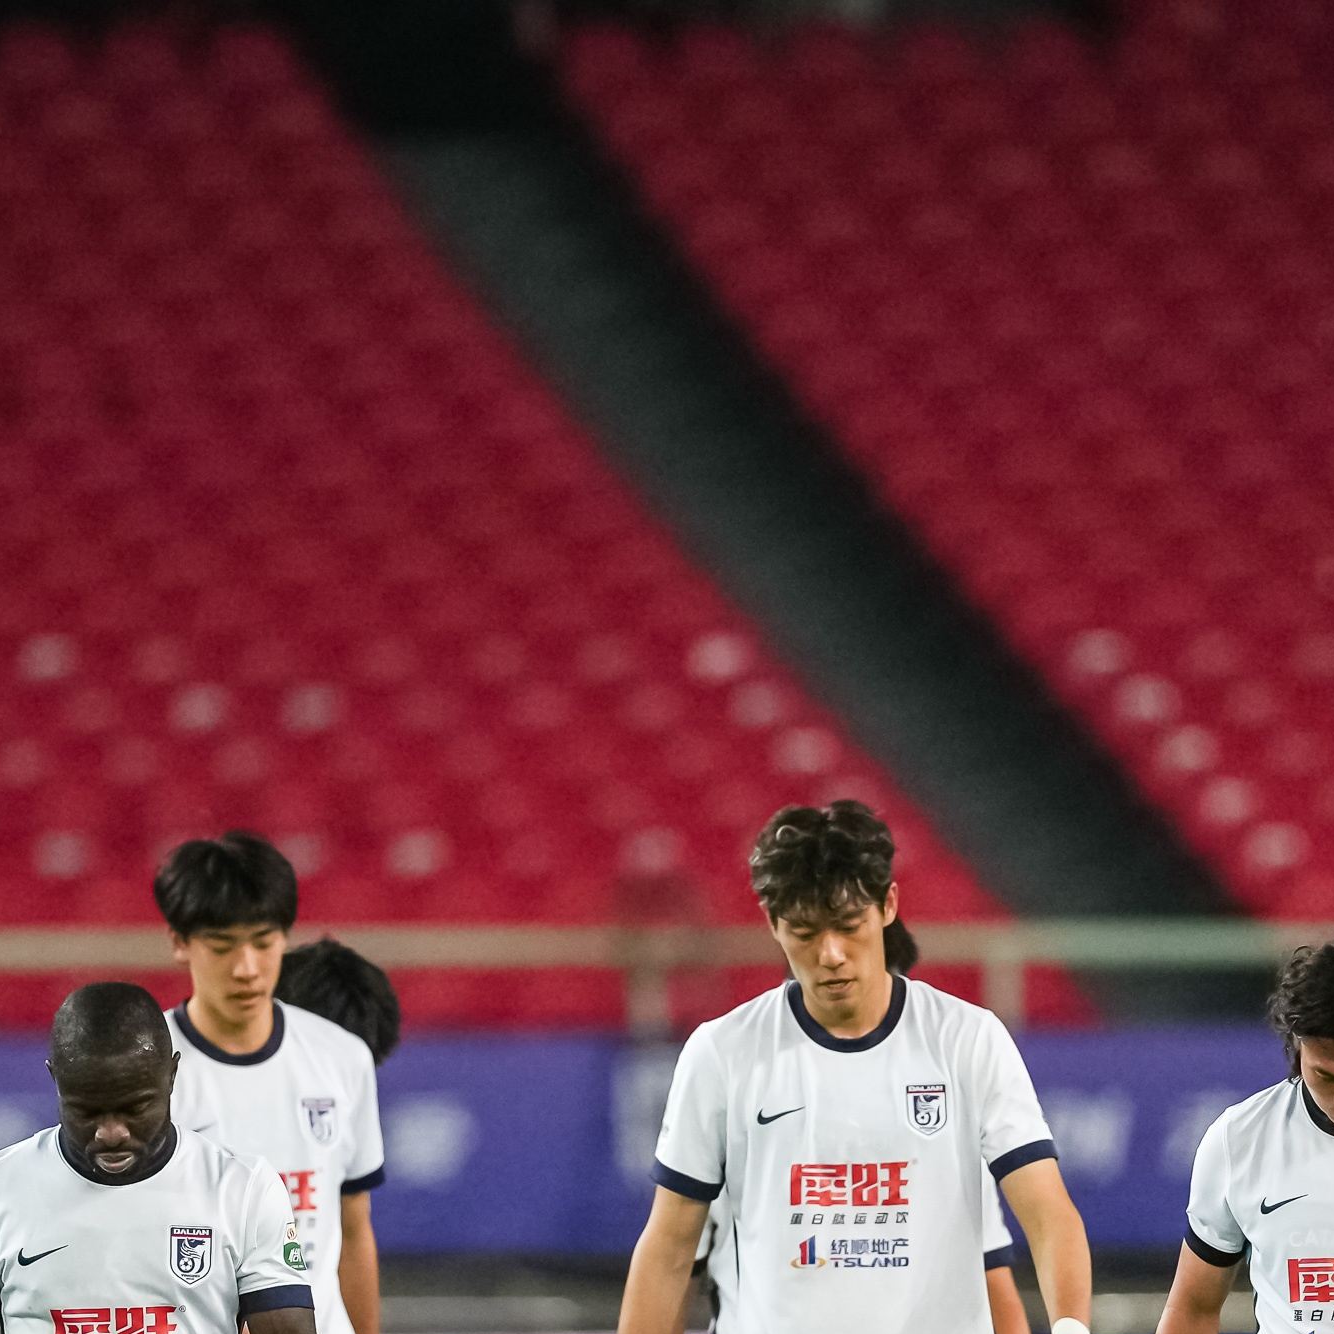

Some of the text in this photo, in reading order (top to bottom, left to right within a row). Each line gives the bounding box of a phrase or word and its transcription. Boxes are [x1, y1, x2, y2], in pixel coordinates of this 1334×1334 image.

[790, 1161, 909, 1206] 犀旺
[173, 1228, 210, 1236] DALIAN
[830, 1257, 909, 1268] TSLAND
